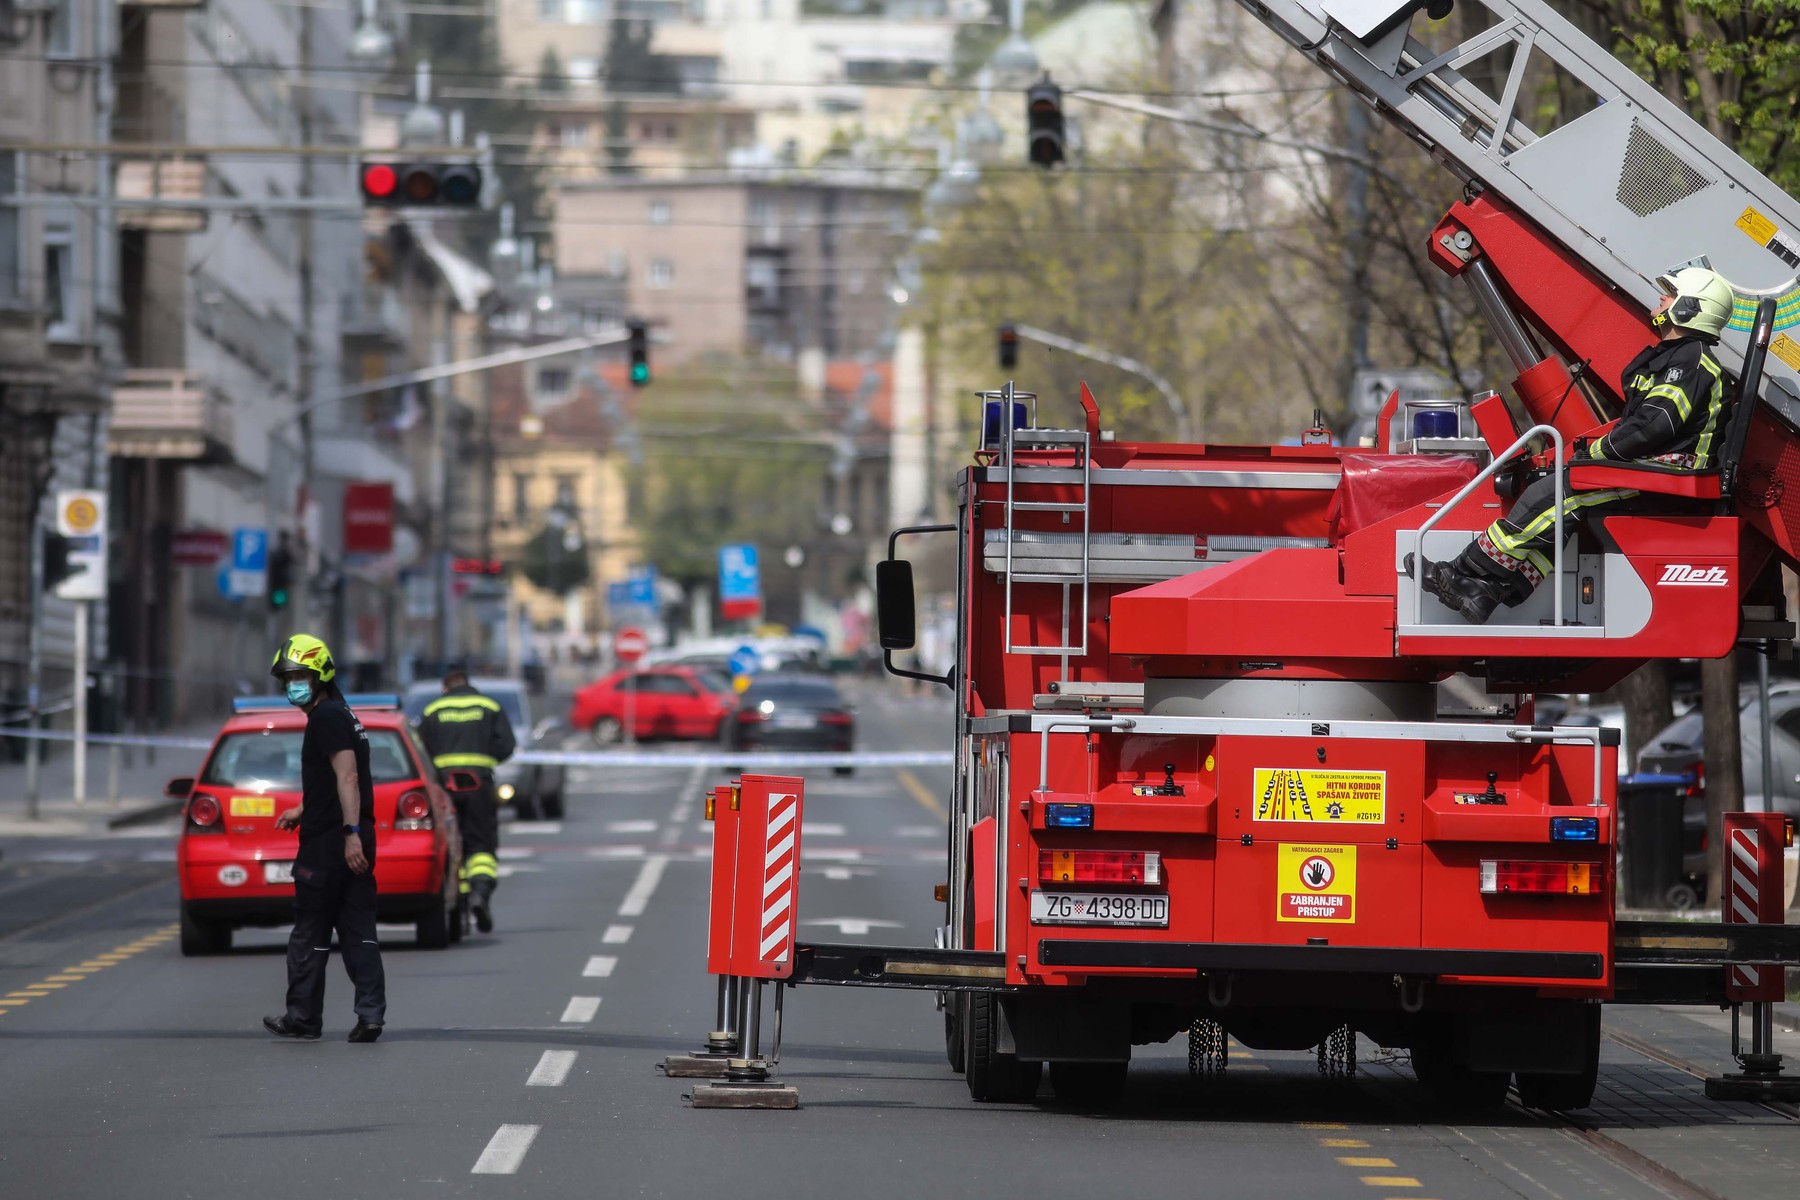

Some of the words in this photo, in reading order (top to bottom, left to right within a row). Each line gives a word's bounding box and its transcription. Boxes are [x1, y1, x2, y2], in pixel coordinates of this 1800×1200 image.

[1657, 565, 1729, 586] Metz
[1326, 781, 1347, 790] HITNI
[1348, 782, 1381, 790] KORIDOR
[1317, 789, 1351, 799] SPAŠAVA
[1352, 790, 1381, 800] ŽIVOTE!
[1357, 812, 1381, 820] #ZG193
[223, 870, 243, 881] HR
[1290, 895, 1343, 906] ZABRANJEN
[1047, 896, 1072, 917] ZG
[1297, 906, 1335, 917] PRISTUP
